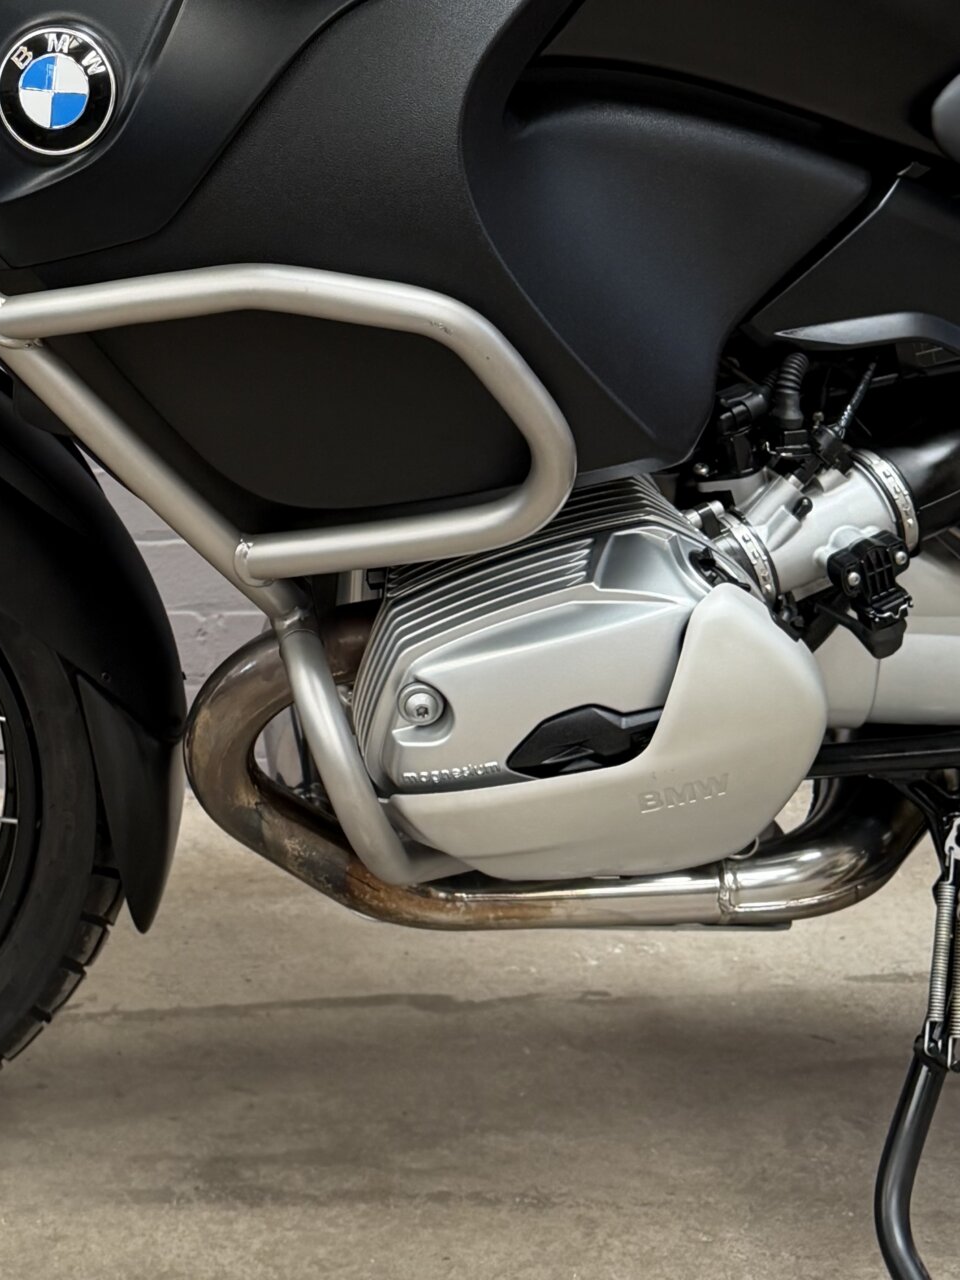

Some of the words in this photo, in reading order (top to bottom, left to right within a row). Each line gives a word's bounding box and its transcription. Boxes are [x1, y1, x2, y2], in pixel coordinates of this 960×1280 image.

[10, 32, 107, 77] BMW
[402, 761, 501, 784] magnesium
[640, 772, 730, 815] BMW
